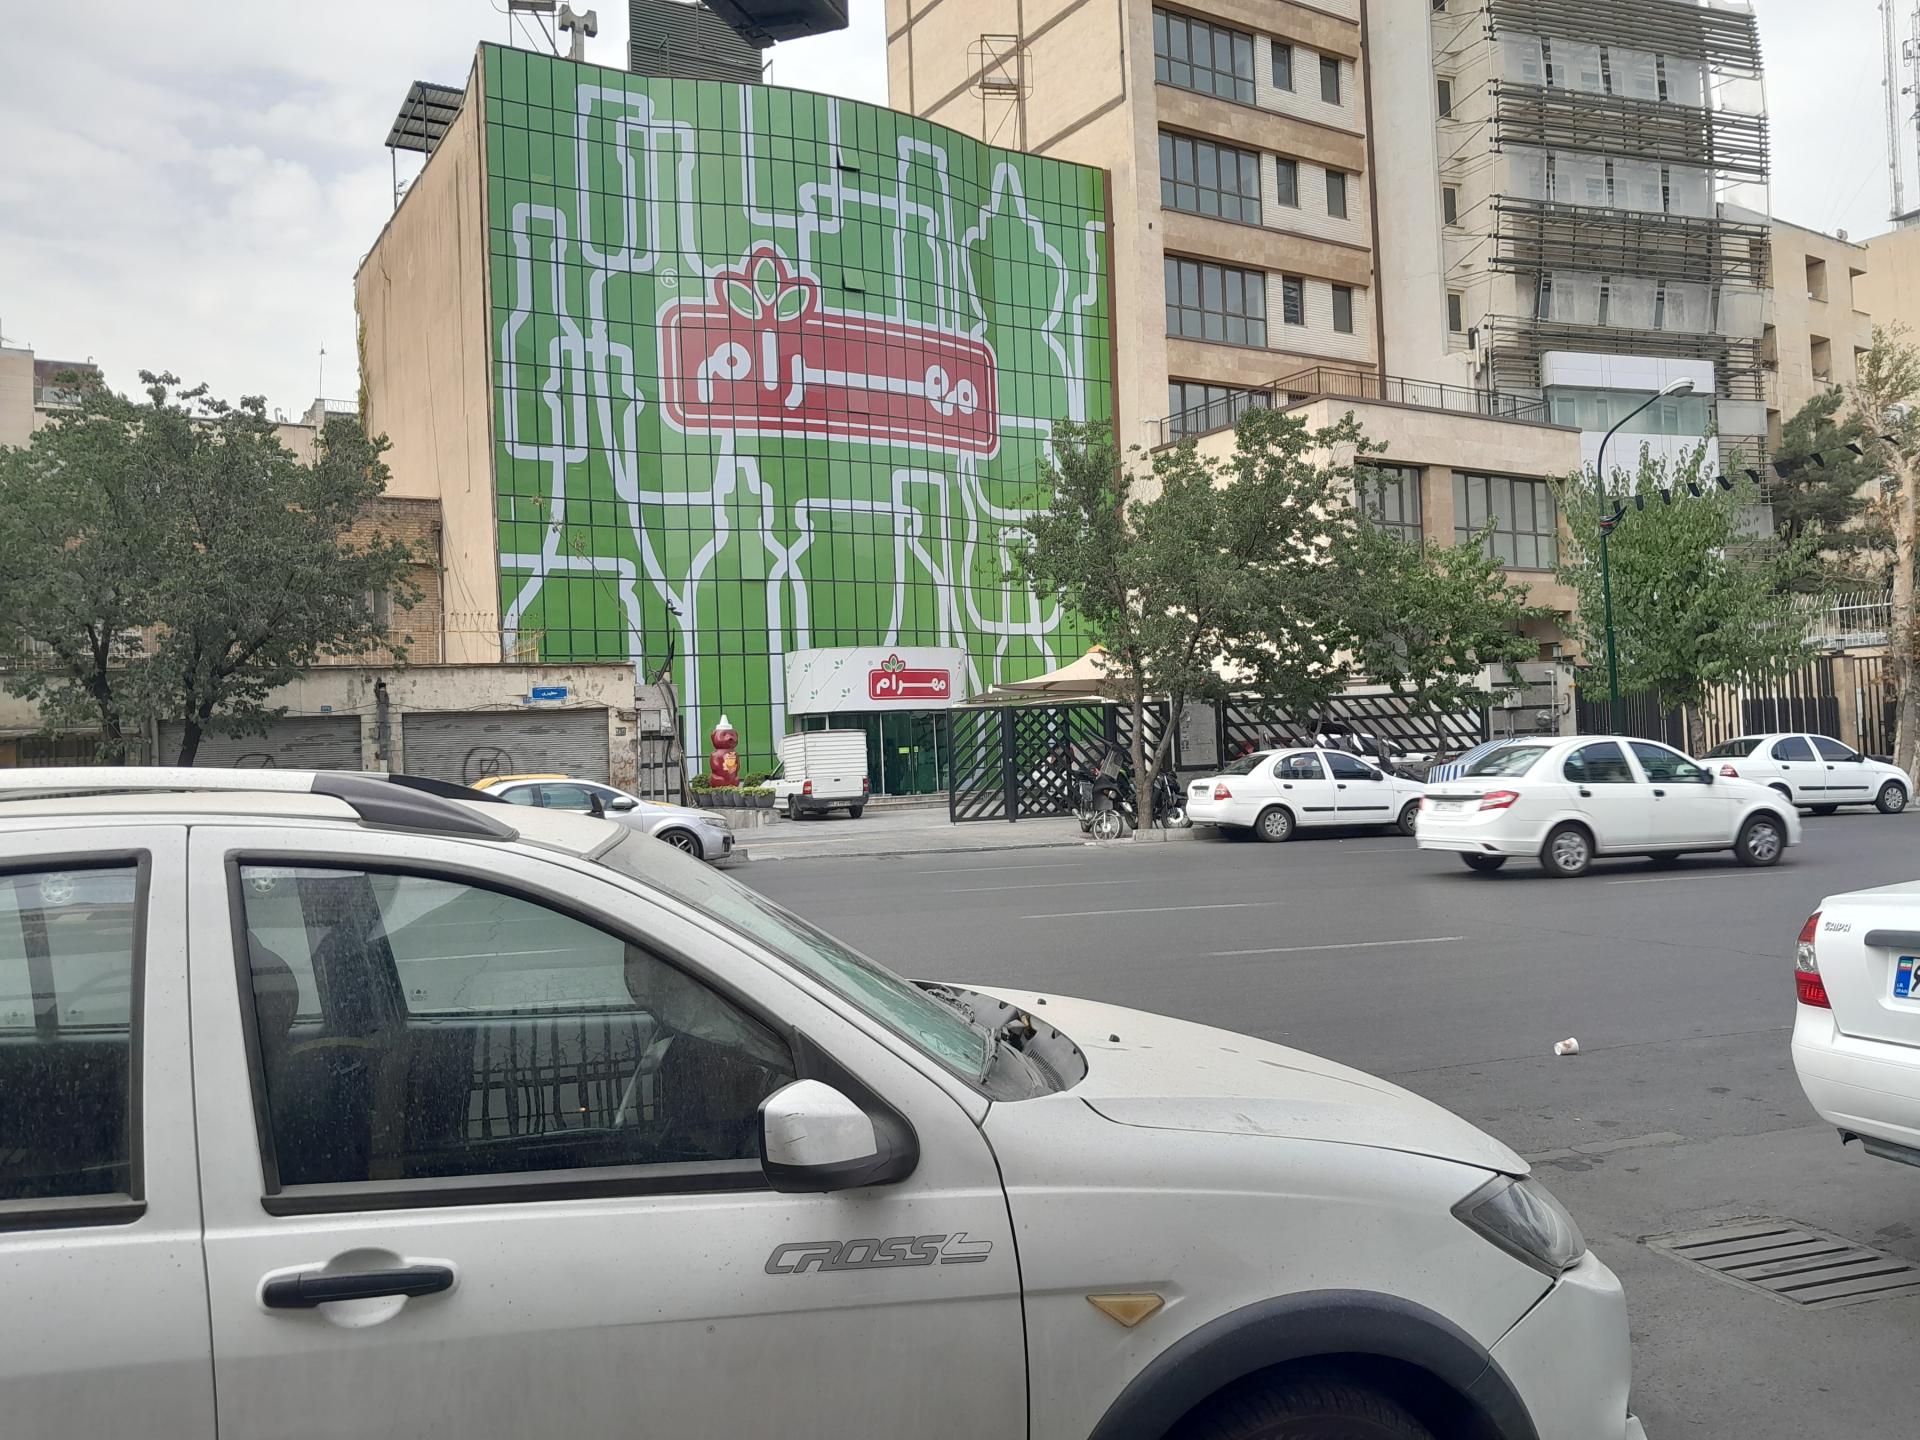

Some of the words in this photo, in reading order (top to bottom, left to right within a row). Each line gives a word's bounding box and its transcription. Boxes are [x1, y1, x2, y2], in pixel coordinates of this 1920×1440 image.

[697, 328, 979, 416] مهرام
[876, 673, 947, 695] مهرام
[1824, 921, 1852, 933] SAIPA
[764, 1234, 947, 1275] CROSS
